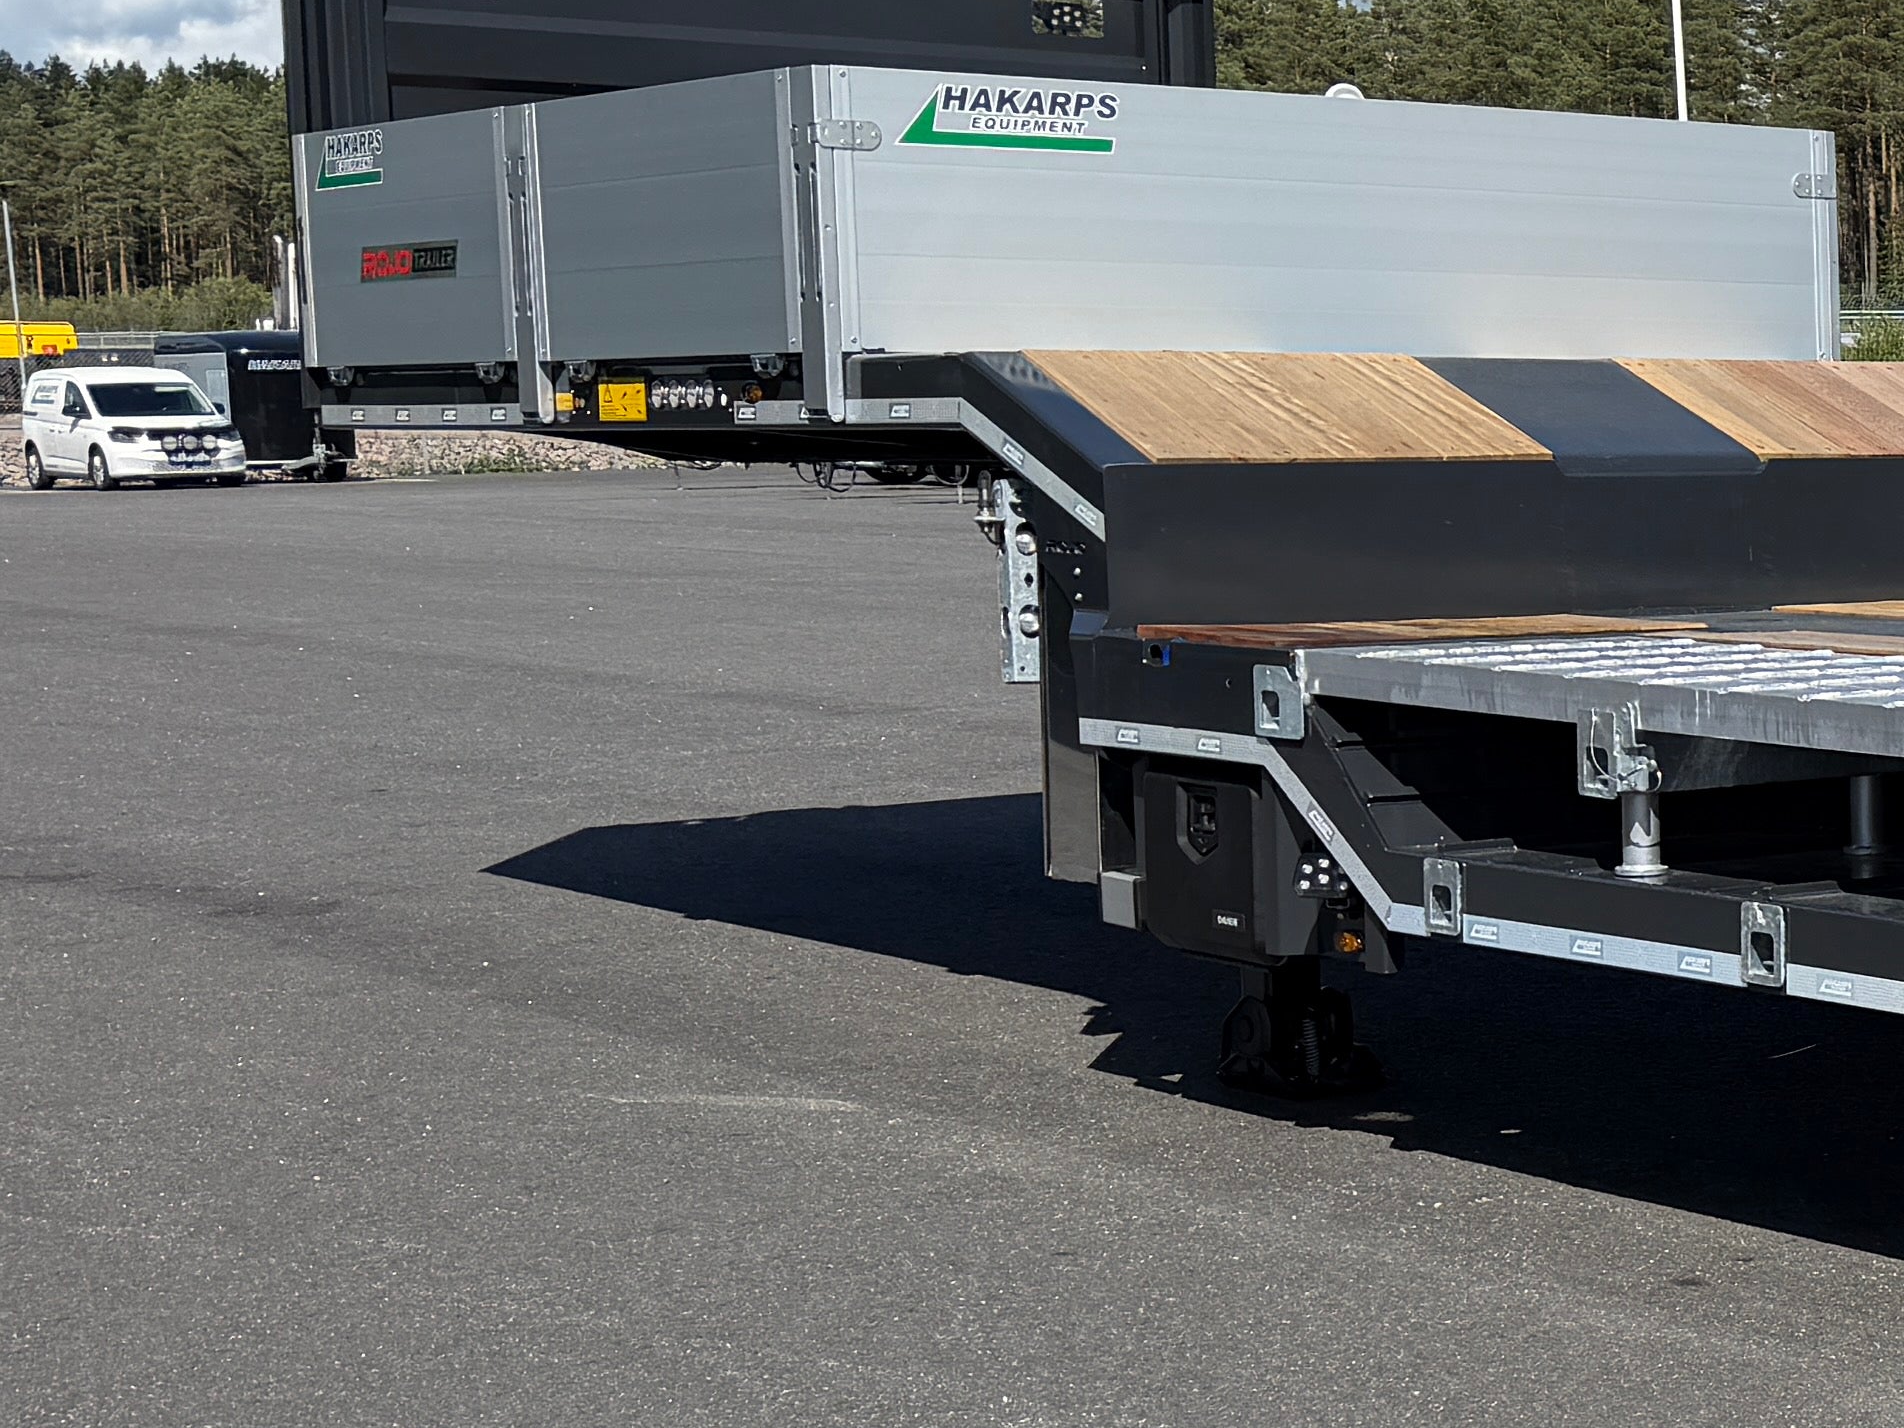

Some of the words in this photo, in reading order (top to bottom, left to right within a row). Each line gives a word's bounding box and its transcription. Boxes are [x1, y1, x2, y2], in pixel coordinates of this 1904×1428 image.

[942, 85, 1119, 120] HAKARPS
[971, 116, 1086, 135] EQUIPMENT
[326, 129, 383, 160] HAKARPS
[362, 248, 413, 280] ROJO
[413, 249, 455, 270] TRAILER
